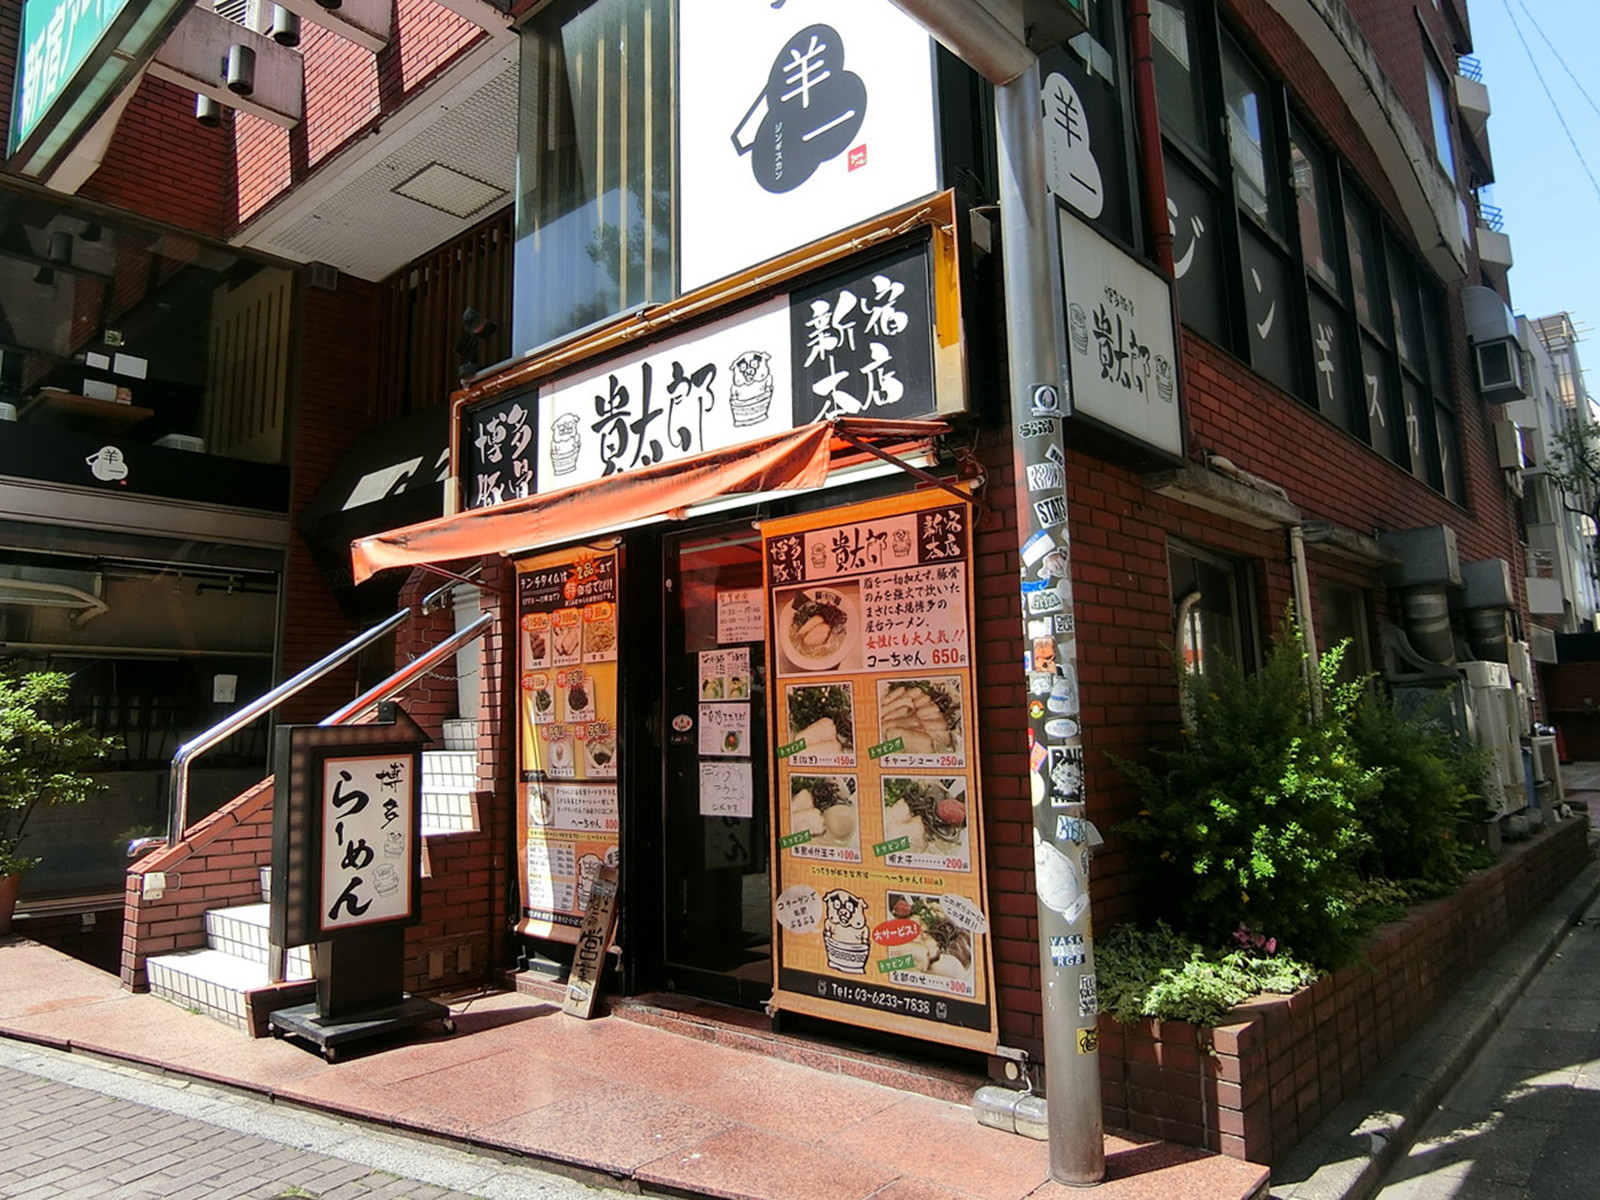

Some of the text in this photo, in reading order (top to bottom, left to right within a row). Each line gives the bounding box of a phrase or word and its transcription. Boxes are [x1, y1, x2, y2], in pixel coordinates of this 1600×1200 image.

[781, 35, 855, 141] 羊一
[1054, 85, 1097, 195] 羊一
[804, 275, 908, 367] 新宿
[1092, 303, 1151, 402] 貴太郎
[808, 342, 904, 425] 本店
[592, 360, 718, 478] 貴太郎
[475, 403, 533, 464] 博多
[923, 510, 962, 539] 新宿
[770, 536, 802, 561] 博多
[831, 527, 888, 573] 貴太郎
[925, 534, 961, 561] 本店
[772, 560, 803, 583] 豚骨
[866, 599, 947, 618] まさに本場博多の
[867, 647, 966, 668] コーちゃん 650円
[869, 739, 902, 757] トッピング
[883, 756, 934, 766] チャーシュー
[375, 763, 404, 830] 博多
[328, 770, 375, 921] らーめん
[875, 838, 909, 854] トッピング
[1050, 935, 1084, 947] VASK
[879, 956, 913, 972] トッピング
[1057, 955, 1082, 967] RGB
[892, 971, 927, 986] 全部のせ
